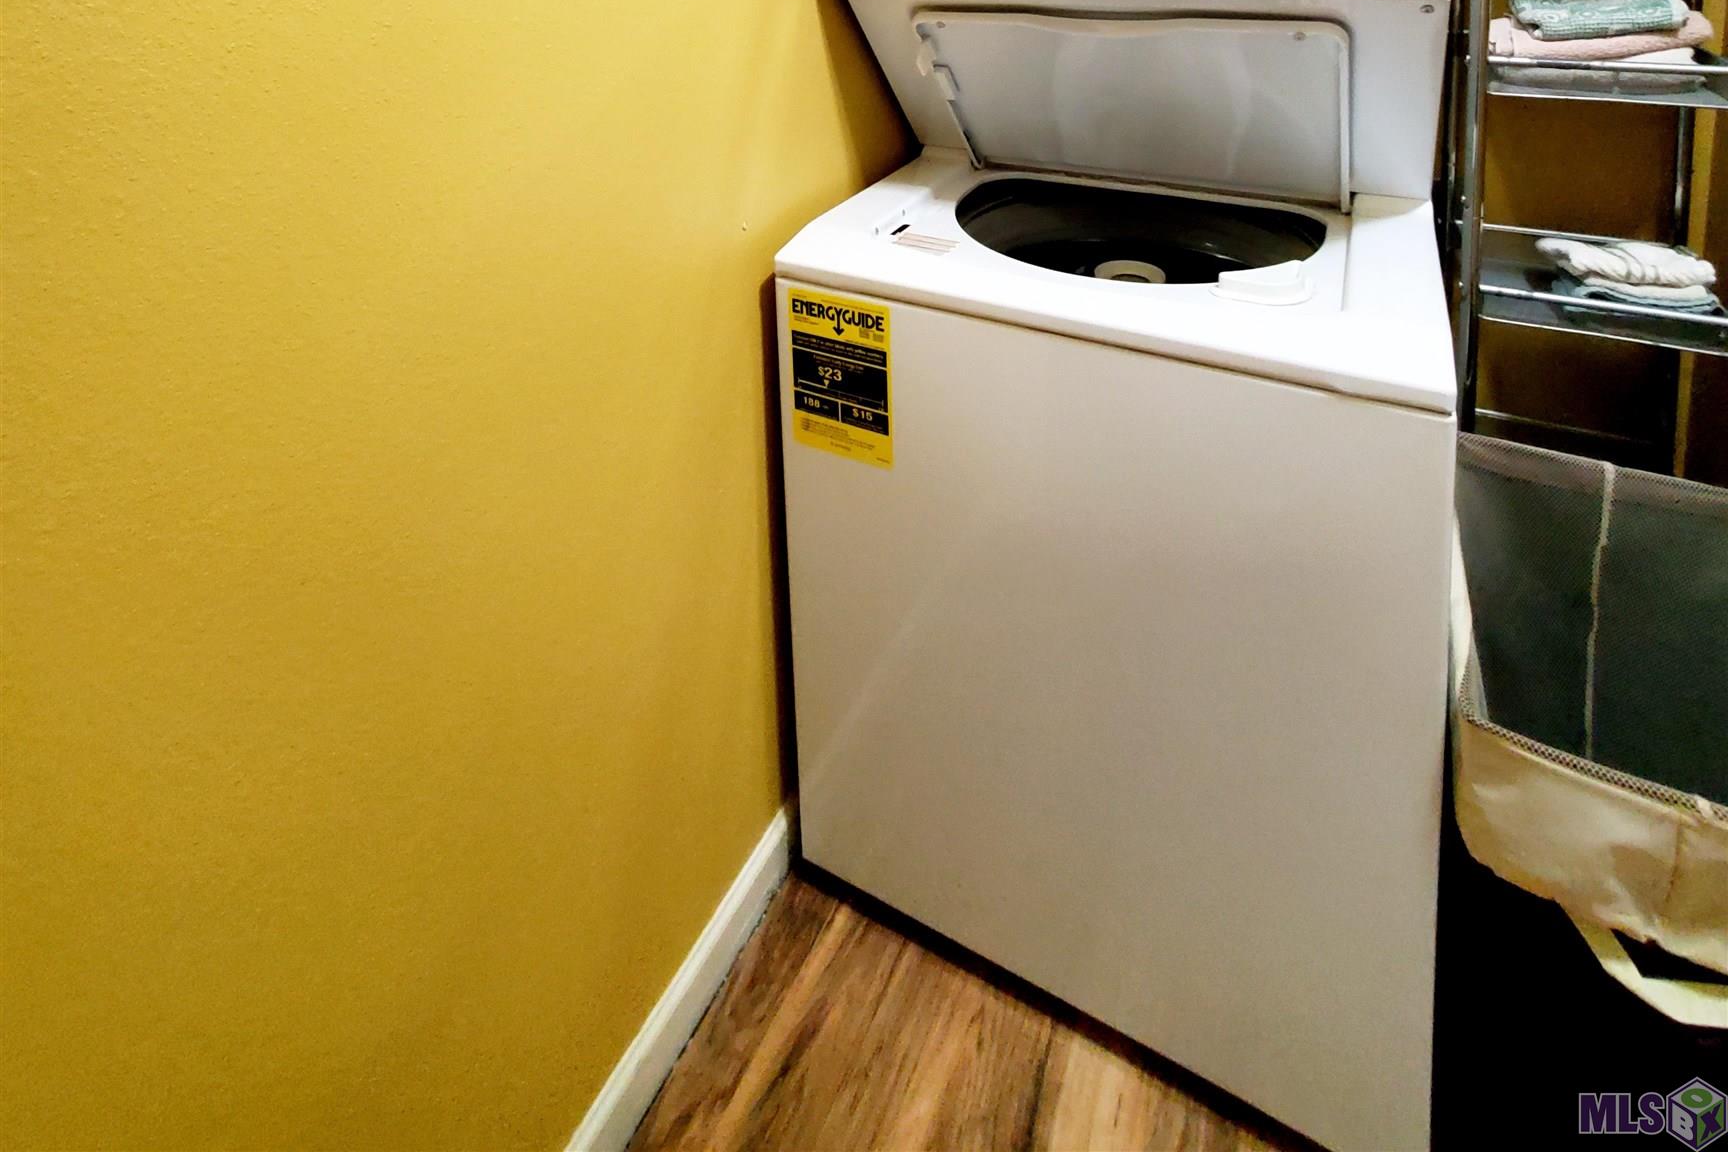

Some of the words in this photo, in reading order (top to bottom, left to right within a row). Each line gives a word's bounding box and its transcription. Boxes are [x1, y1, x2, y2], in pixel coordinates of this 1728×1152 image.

[791, 297, 885, 333] ENERGYGUIDE
[817, 365, 843, 382] $23
[852, 408, 873, 422] $15
